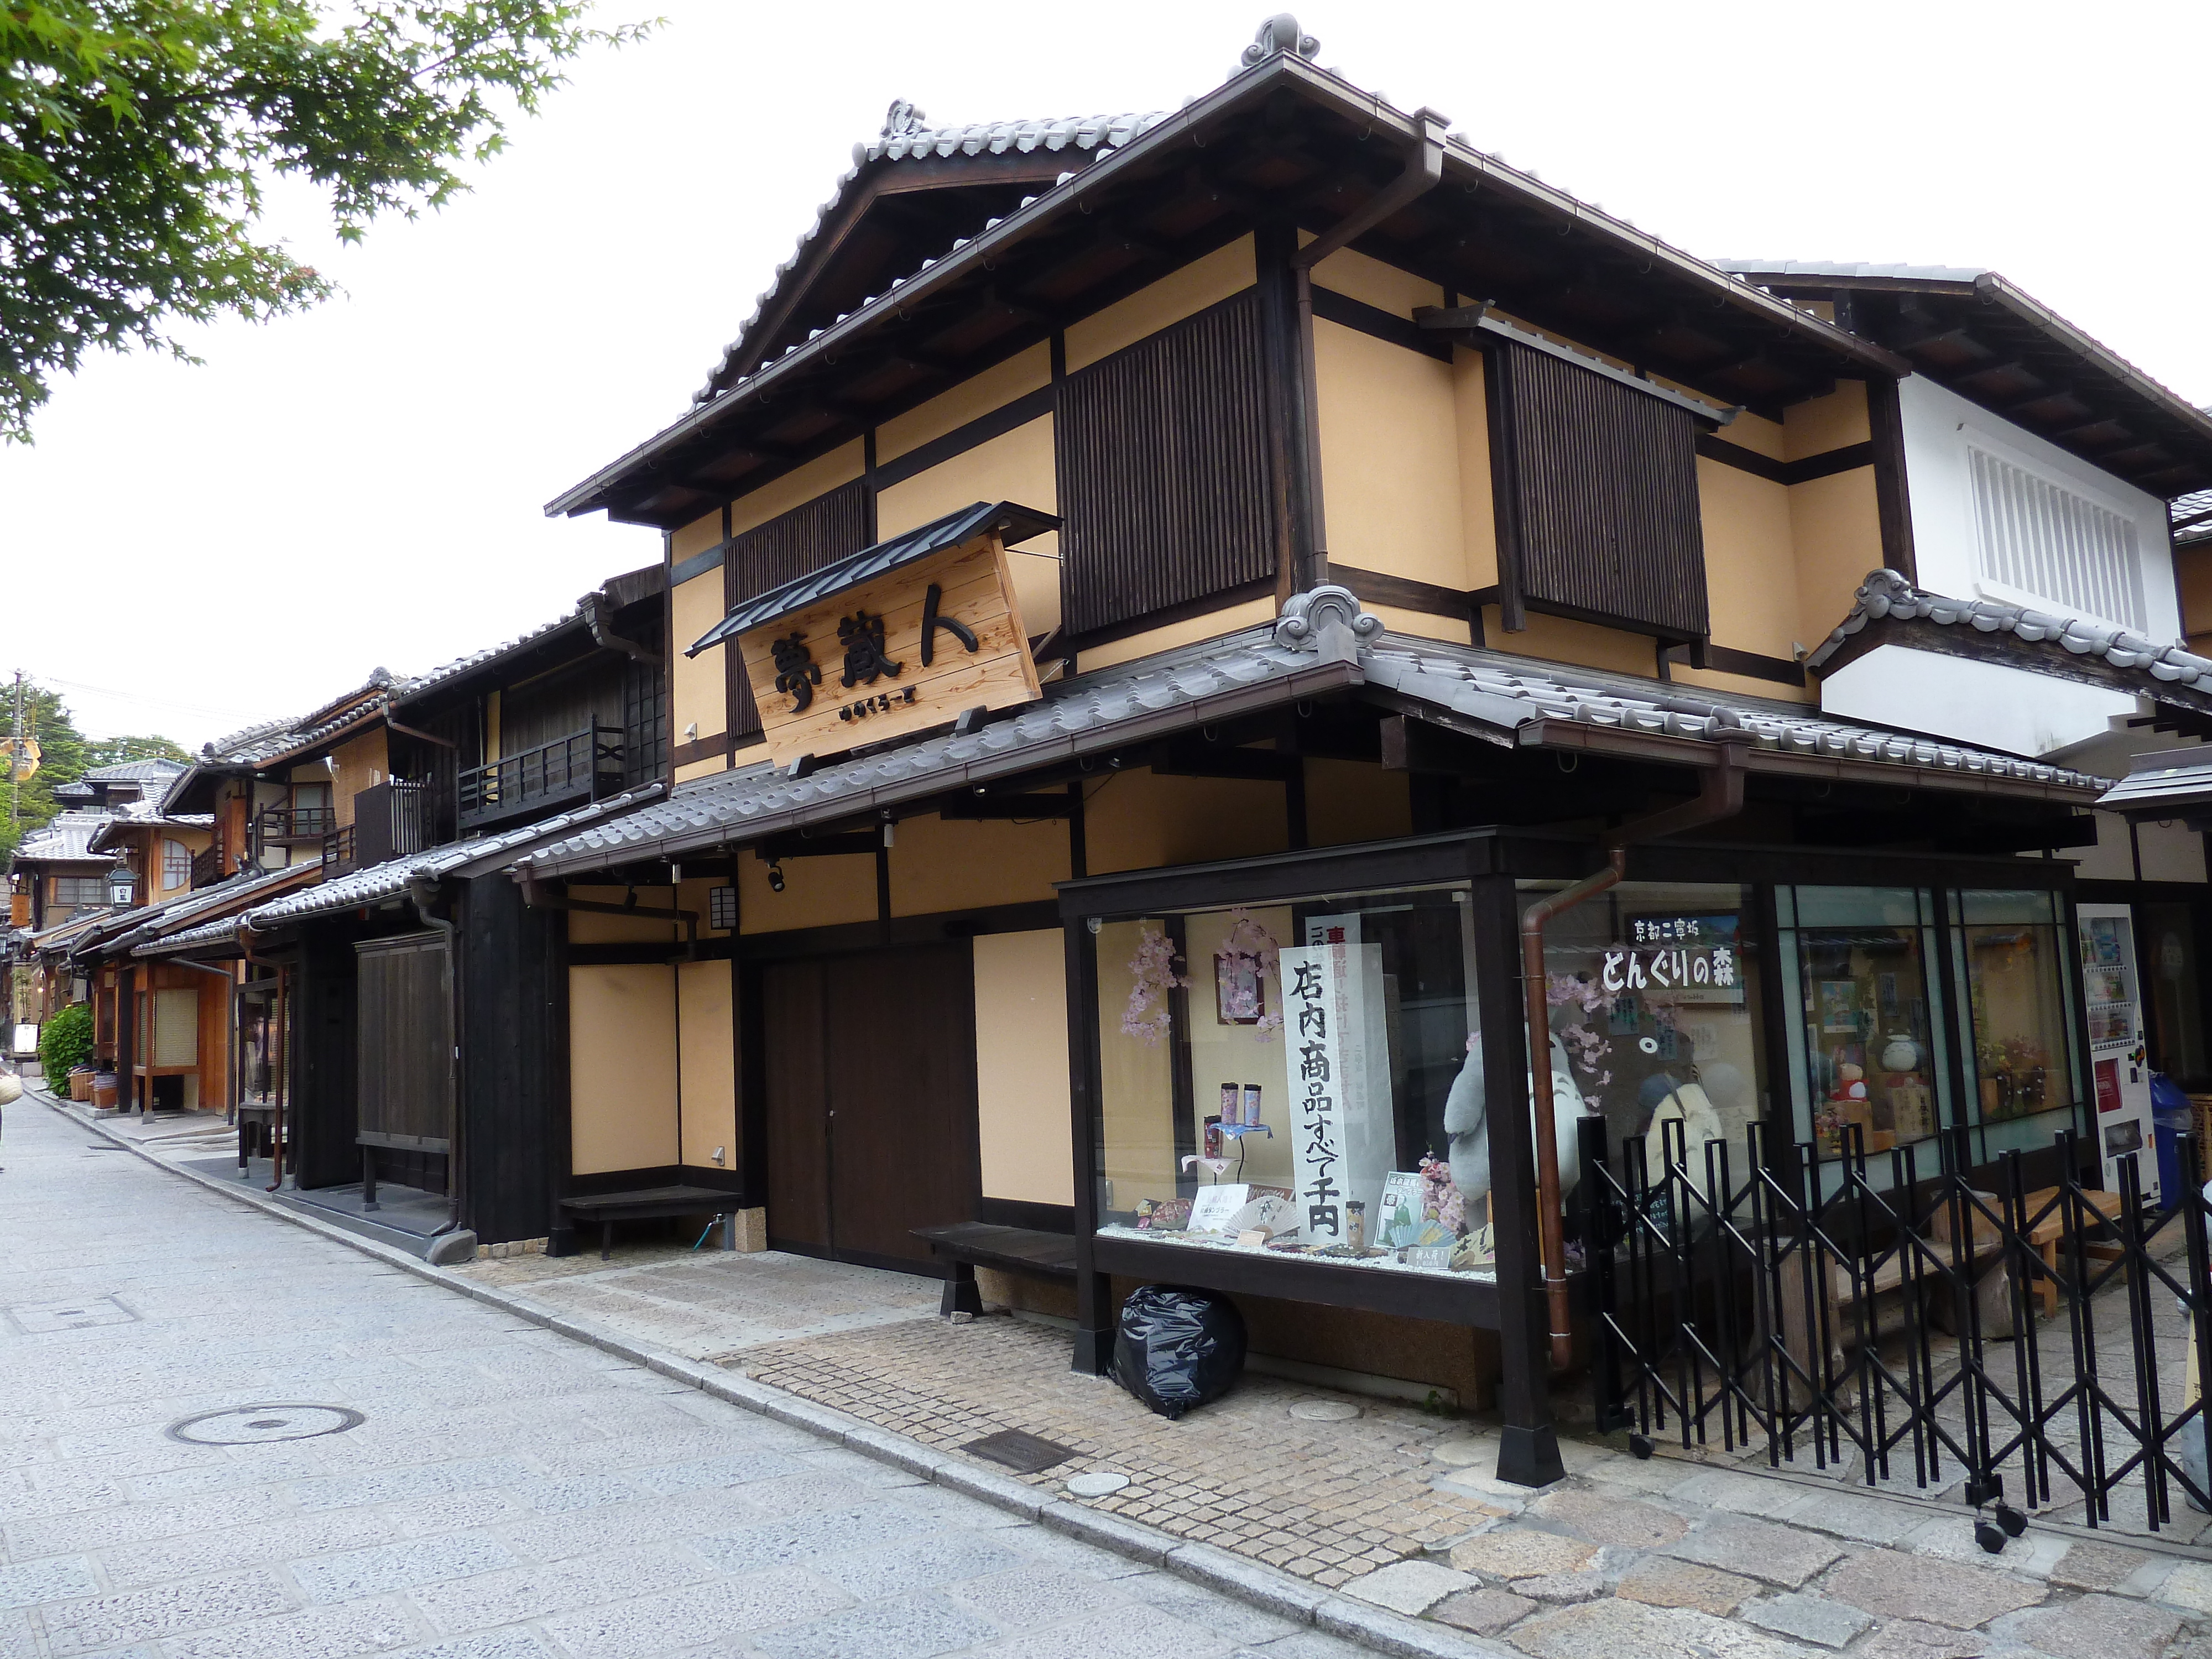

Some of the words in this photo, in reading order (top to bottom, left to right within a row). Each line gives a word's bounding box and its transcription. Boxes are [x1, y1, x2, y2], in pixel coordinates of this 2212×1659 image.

[770, 583, 978, 713] 夢蔵人
[1603, 947, 1734, 992] どんぐりの森
[1289, 960, 1340, 1237] 店内商品すべて千円
